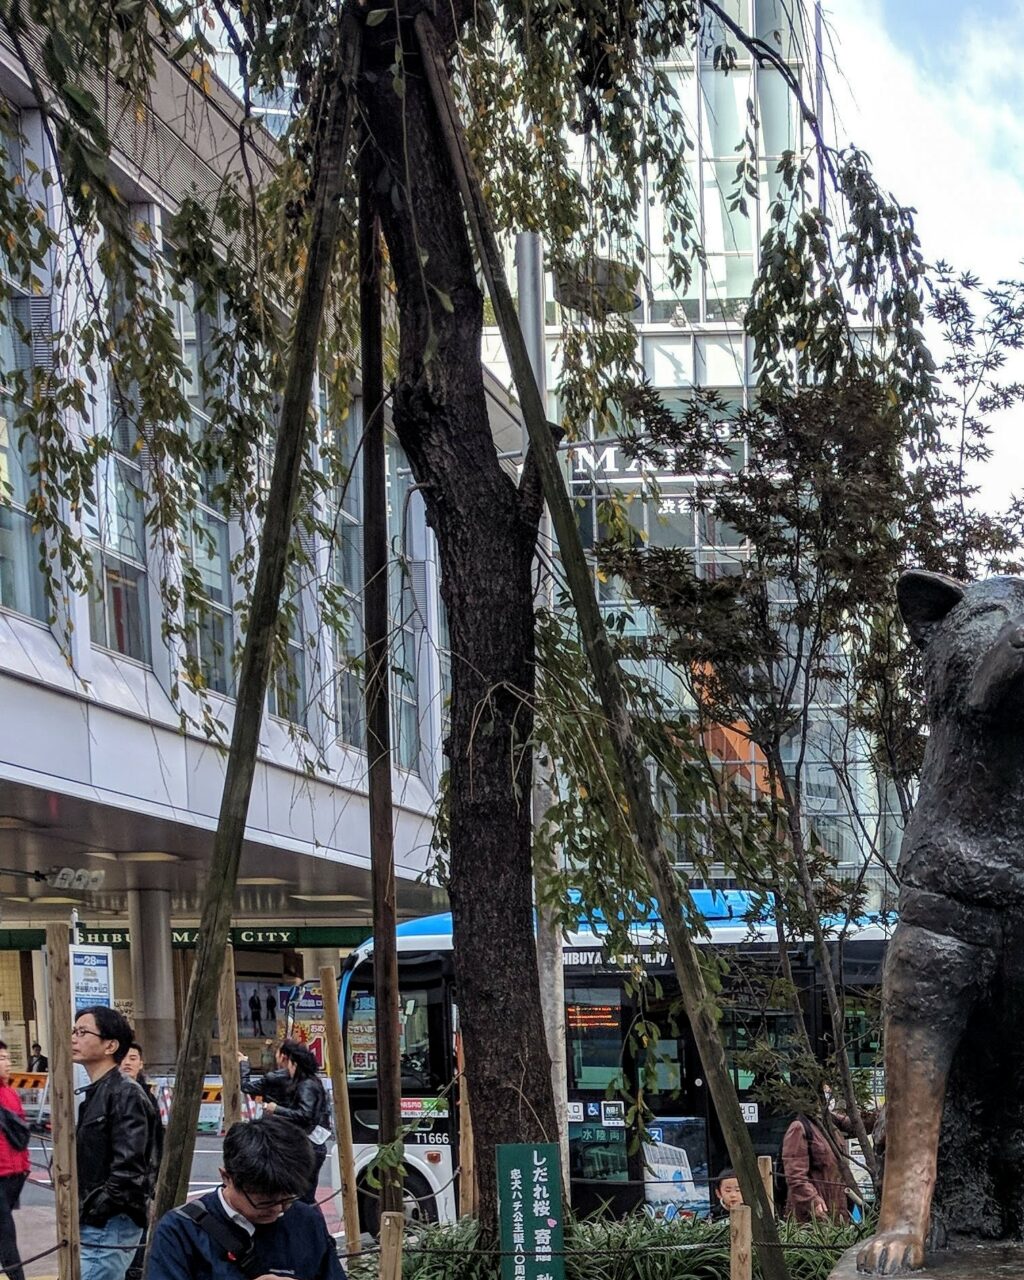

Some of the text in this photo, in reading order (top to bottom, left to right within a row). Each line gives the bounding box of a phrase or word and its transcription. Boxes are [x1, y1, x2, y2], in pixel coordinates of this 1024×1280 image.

[240, 930, 292, 943] CITY
[83, 955, 98, 966] 28
[415, 1132, 450, 1144] T1666
[532, 1150, 551, 1217] しだれ桜
[534, 1228, 552, 1262] 寄贈
